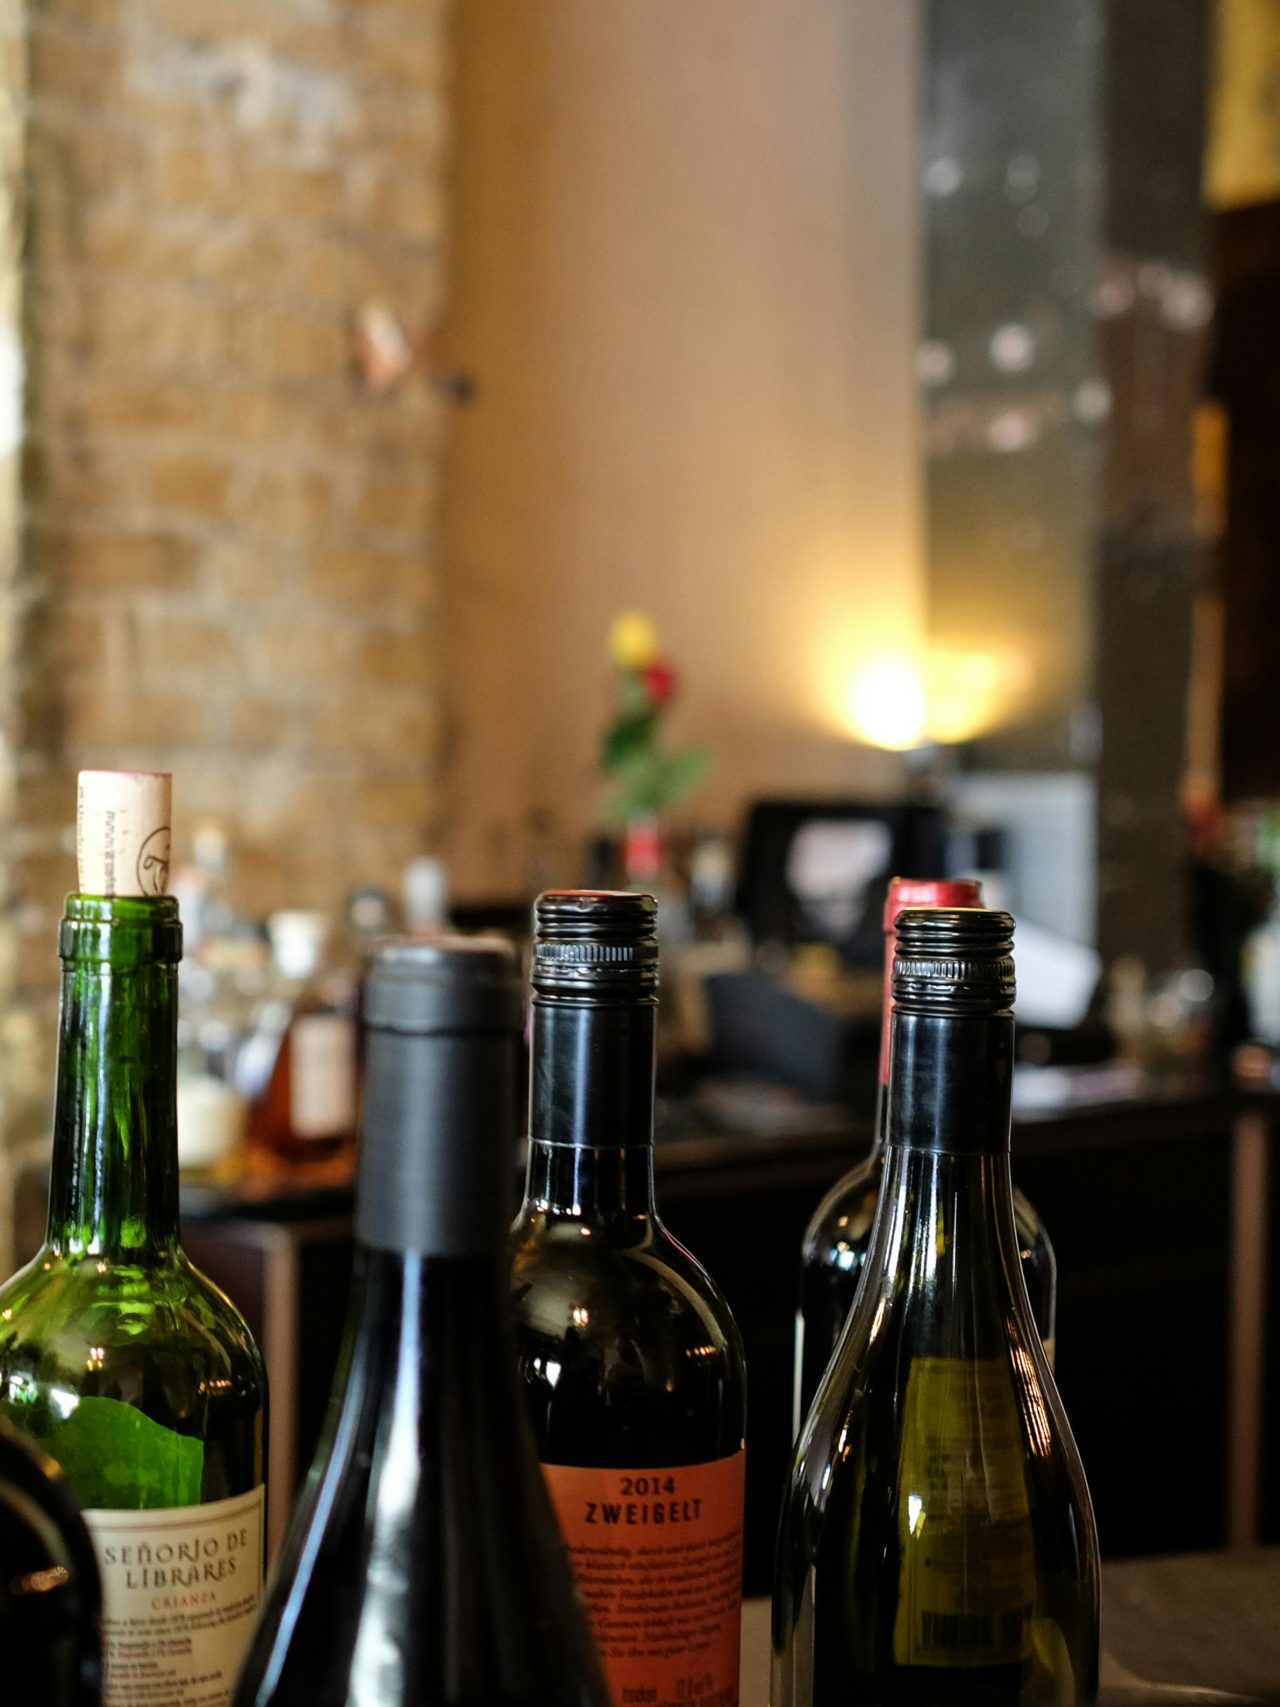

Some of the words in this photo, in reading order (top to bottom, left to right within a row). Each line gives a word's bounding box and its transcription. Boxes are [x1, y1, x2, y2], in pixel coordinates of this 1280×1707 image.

[621, 1477, 676, 1496] 2014
[585, 1500, 703, 1525] ZWEIGELT
[226, 1529, 248, 1549] DE
[126, 1557, 237, 1590] LIBRARES
[150, 1591, 217, 1611] CRIANZA
